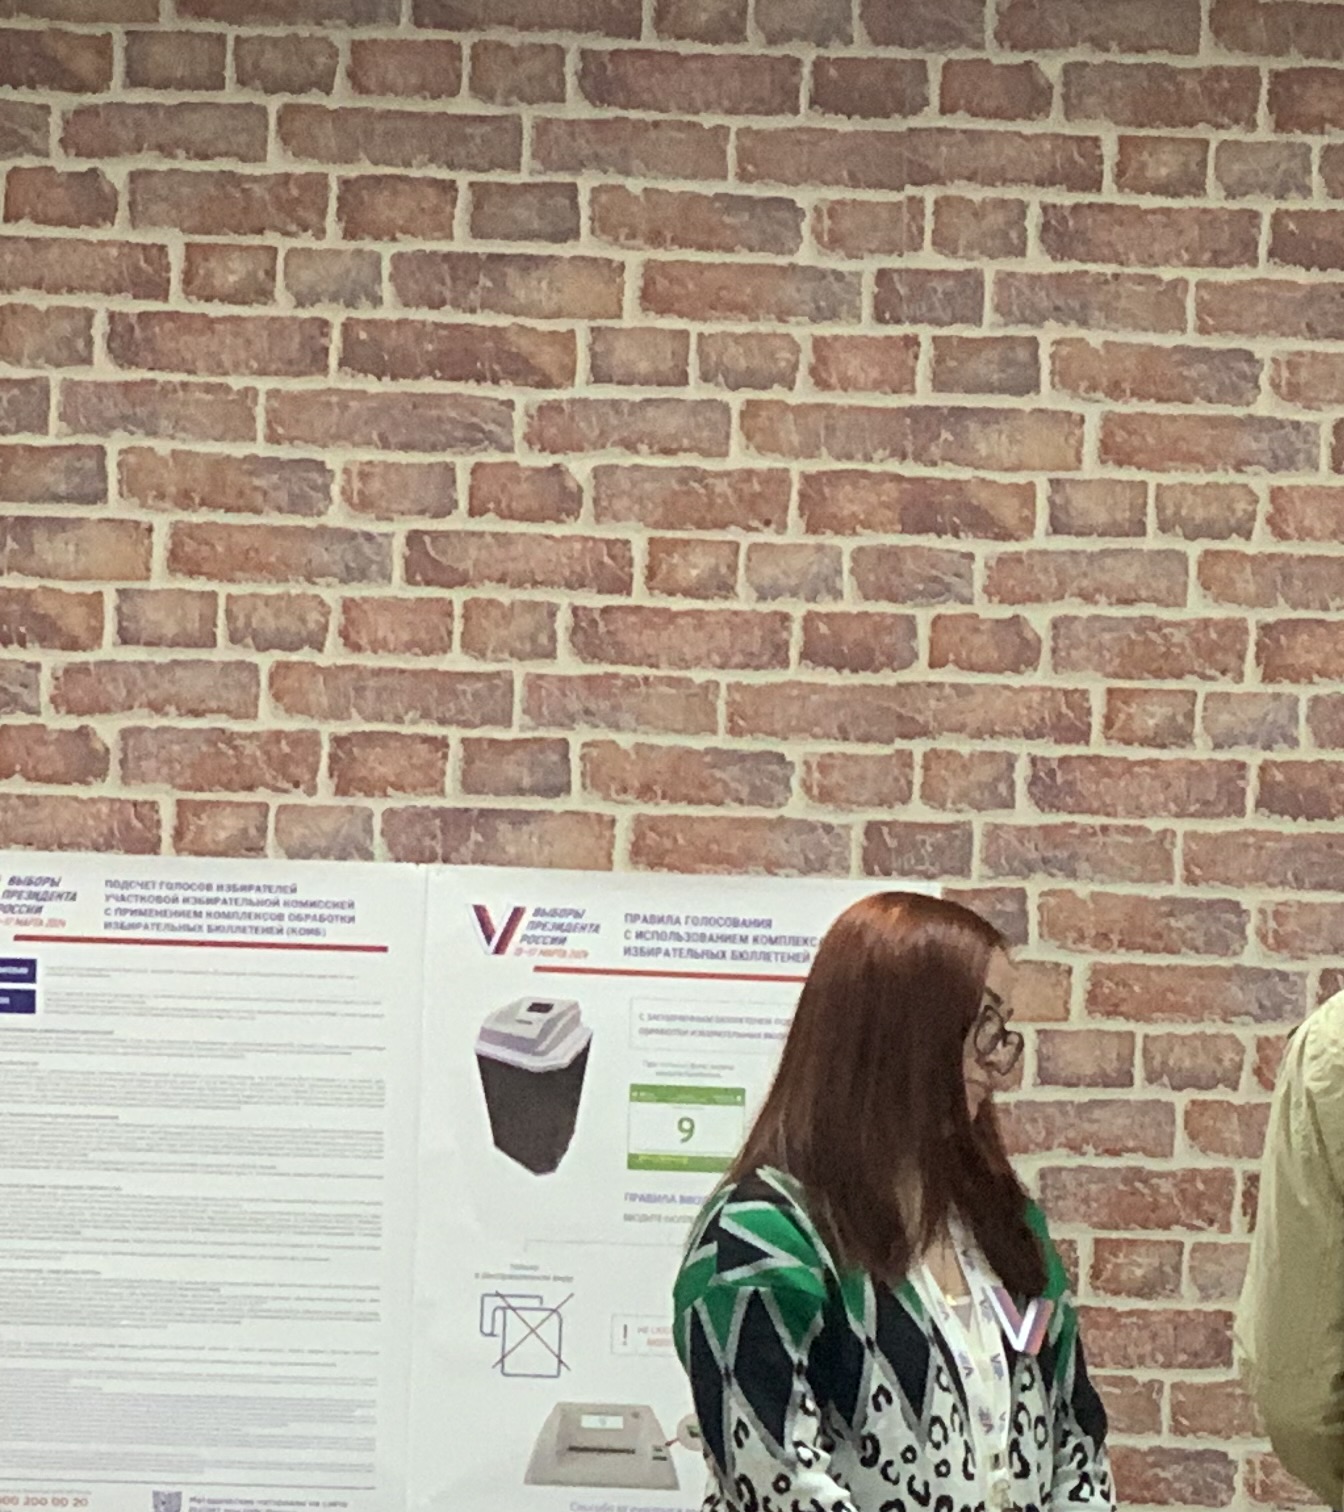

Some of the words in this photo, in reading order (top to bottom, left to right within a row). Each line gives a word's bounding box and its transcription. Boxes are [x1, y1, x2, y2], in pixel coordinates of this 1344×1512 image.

[159, 881, 213, 891] ГОЛОСОВ
[624, 913, 681, 926] ПРАВИЛА
[684, 915, 773, 929] ГОЛОСОВАНИЯ
[519, 934, 567, 945] РОССИИ
[624, 929, 632, 940] С
[635, 930, 749, 944] ИСПОЛЬЗОВАНИЕМ
[752, 934, 823, 947] КОМПЛЕКС
[624, 946, 726, 960] ИЗБИРАТЕЛЬНЫХ
[677, 1116, 695, 1143] 9
